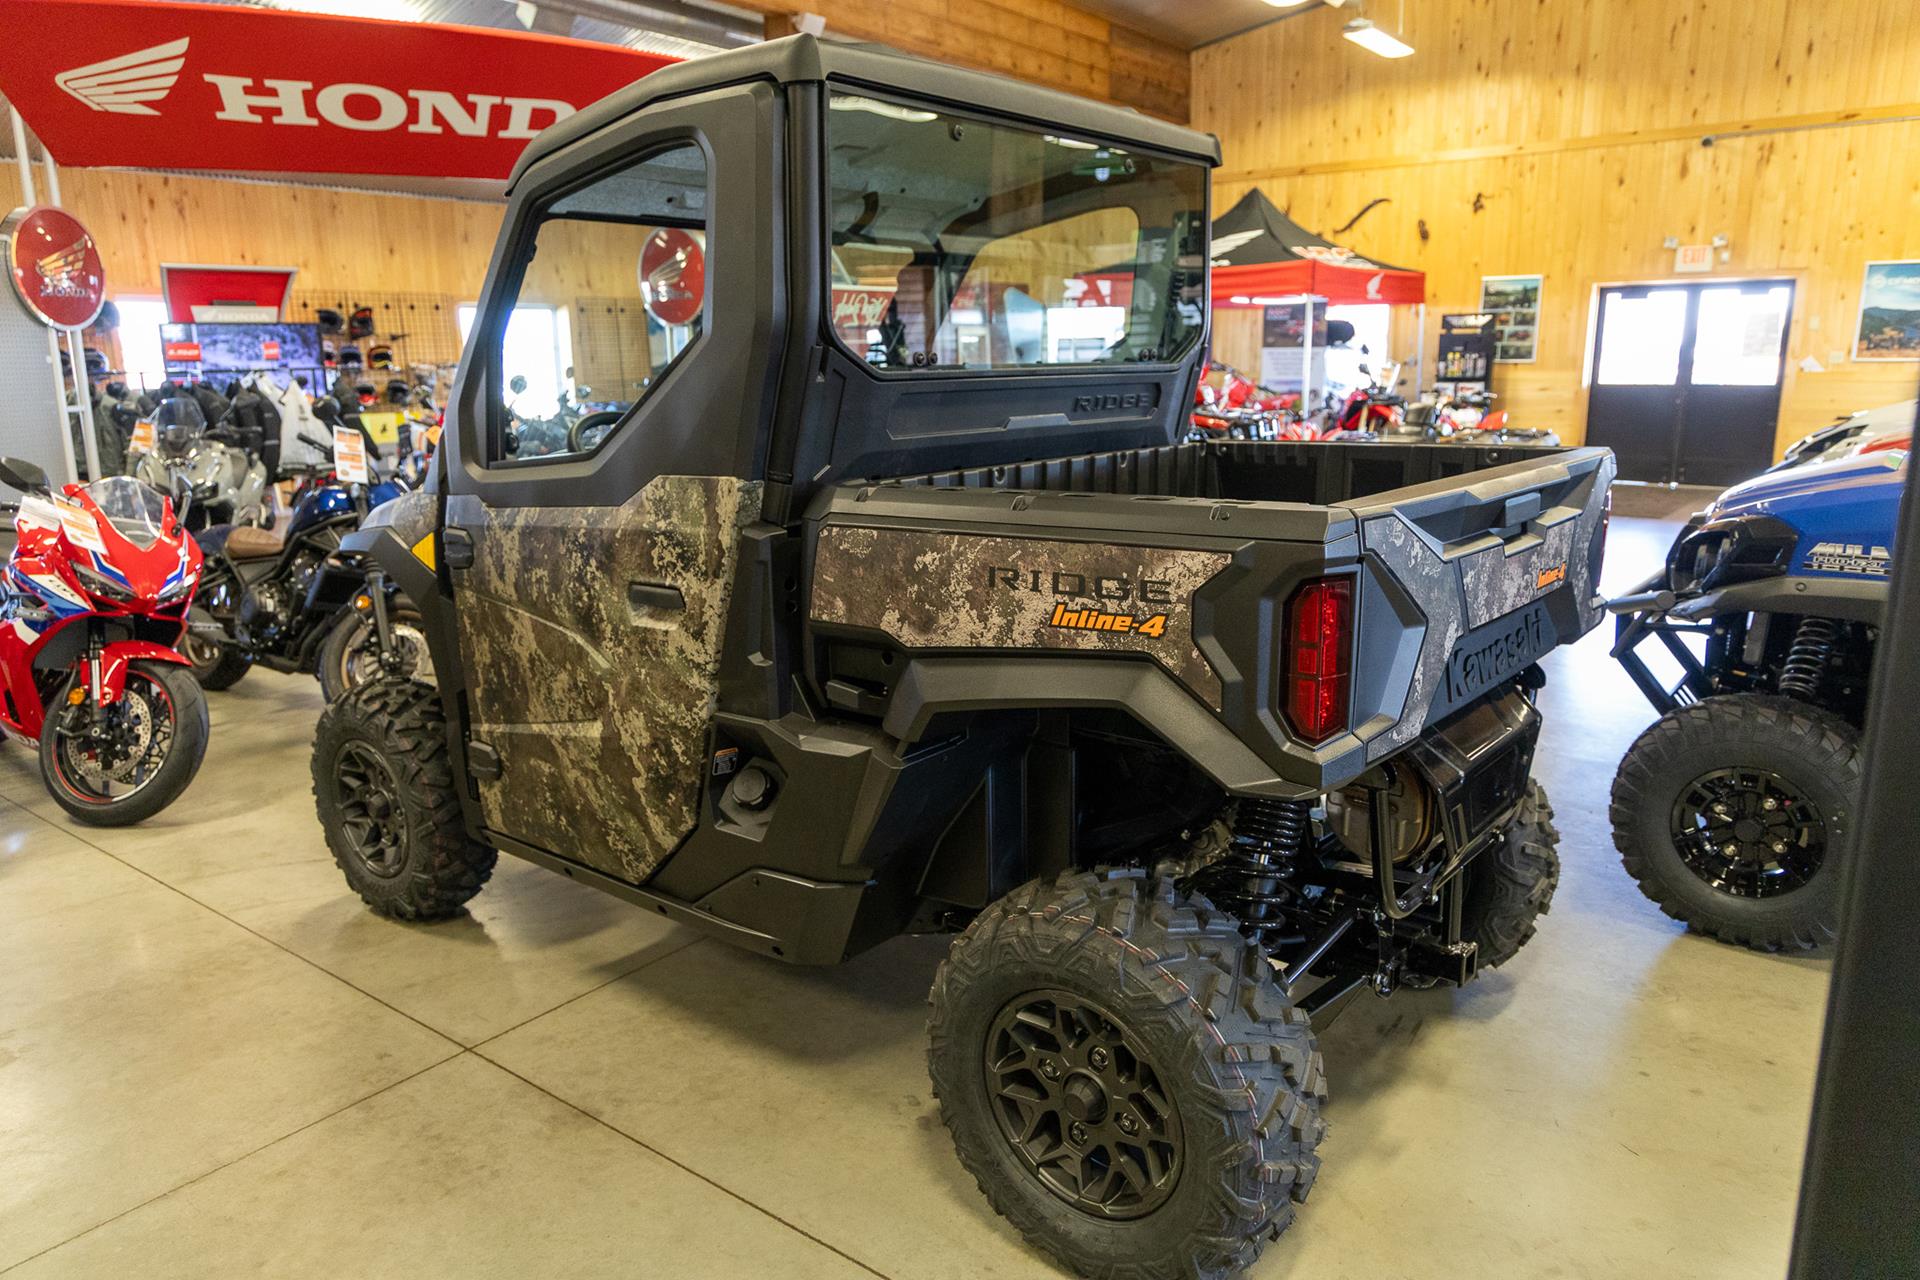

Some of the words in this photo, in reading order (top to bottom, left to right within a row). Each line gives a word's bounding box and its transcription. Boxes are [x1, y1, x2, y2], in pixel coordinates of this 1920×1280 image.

[203, 73, 578, 139] HOND
[1073, 393, 1150, 412] RIDGE
[988, 566, 1172, 604] RIDGE
[1051, 603, 1167, 638] Inline-4
[1446, 607, 1544, 703] Kawasaki
